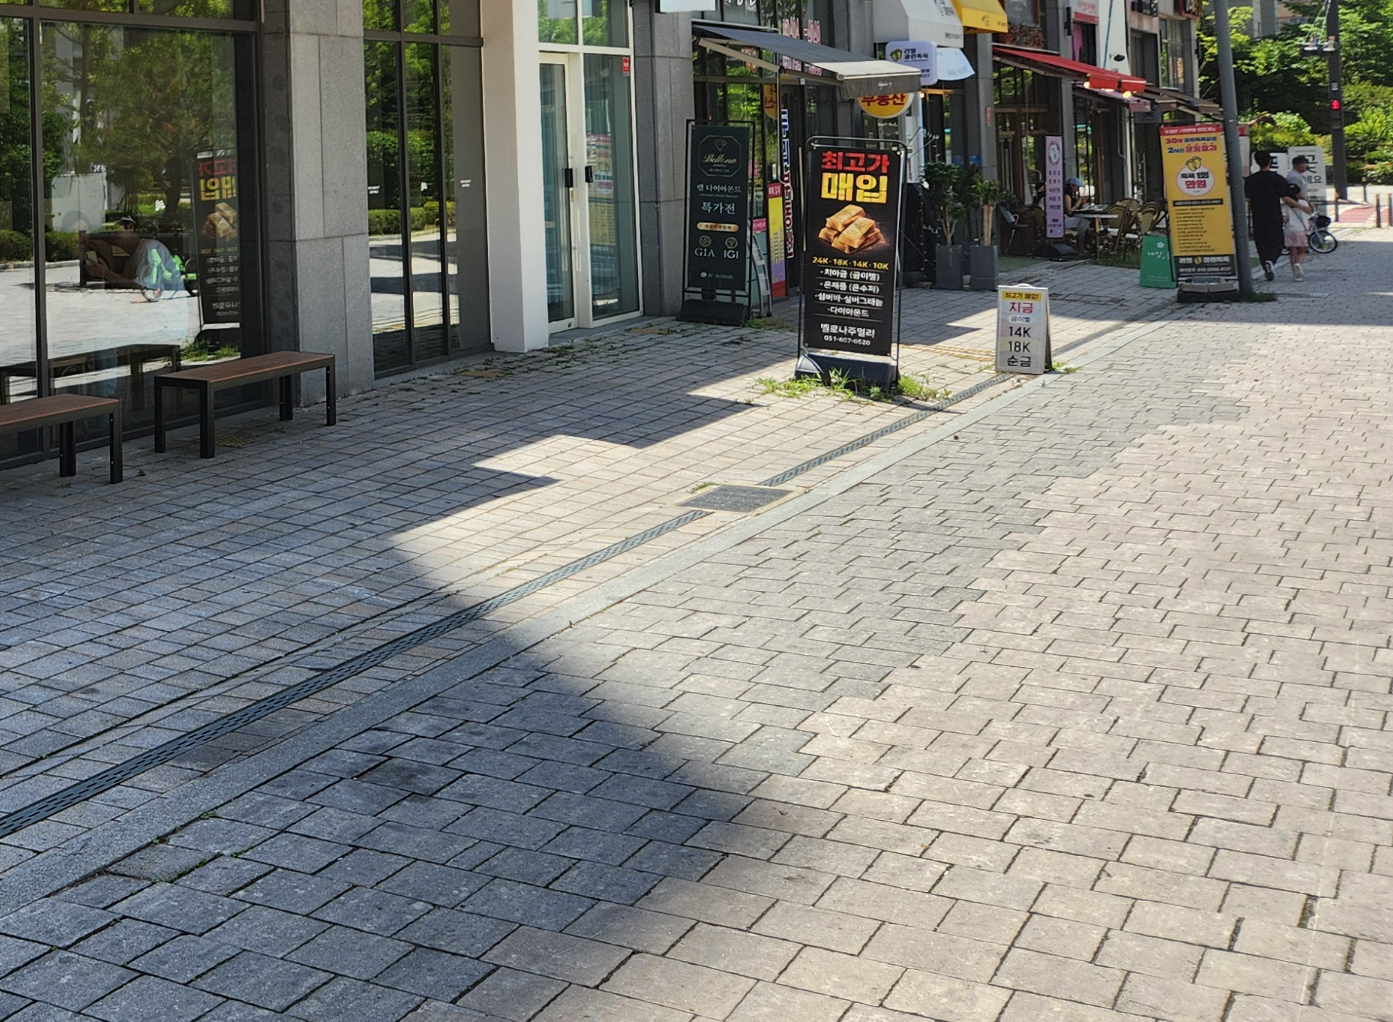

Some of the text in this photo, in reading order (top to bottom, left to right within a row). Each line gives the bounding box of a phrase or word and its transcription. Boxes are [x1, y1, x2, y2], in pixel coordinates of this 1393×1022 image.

[821, 151, 890, 173] 최고가
[706, 184, 742, 193] 다이아몬드
[821, 172, 888, 204] 매입
[701, 201, 736, 215] 특가전
[694, 248, 739, 259] GIA IGI
[812, 256, 889, 270] 24K 18K 14K 10K
[829, 306, 870, 317] 다이아몬드
[1009, 302, 1034, 313] 치금
[820, 323, 876, 338] 벨로나주얼리
[1009, 326, 1032, 338] 14K
[1008, 341, 1031, 353] 18K
[1007, 355, 1032, 367] 순금
